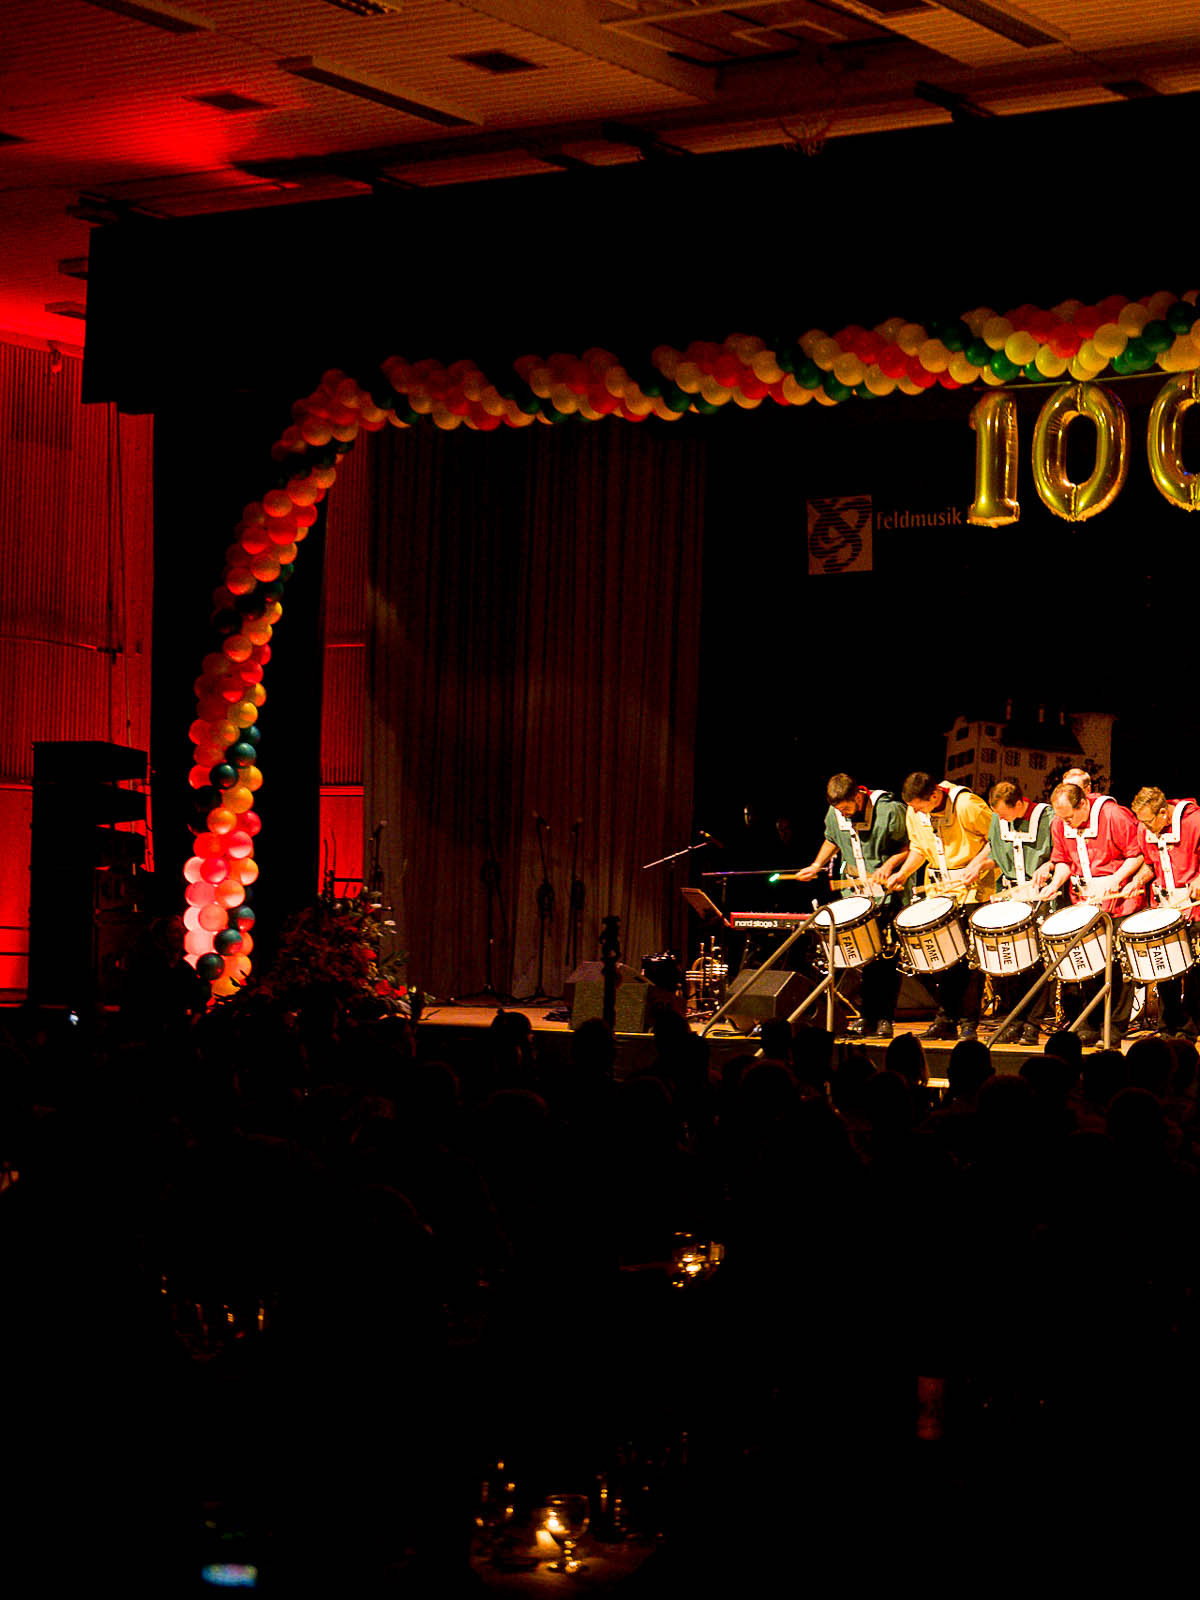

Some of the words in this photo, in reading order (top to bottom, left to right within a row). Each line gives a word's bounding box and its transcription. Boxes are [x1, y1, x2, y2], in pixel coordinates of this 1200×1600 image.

[876, 504, 963, 529] feldmusik
[735, 919, 751, 927] nord
[752, 920, 772, 928] stage
[842, 936, 857, 960] FAME
[923, 938, 939, 963] FAME
[1000, 941, 1013, 965] FAME
[1072, 945, 1086, 970] FAME
[1152, 945, 1166, 971] FAME
